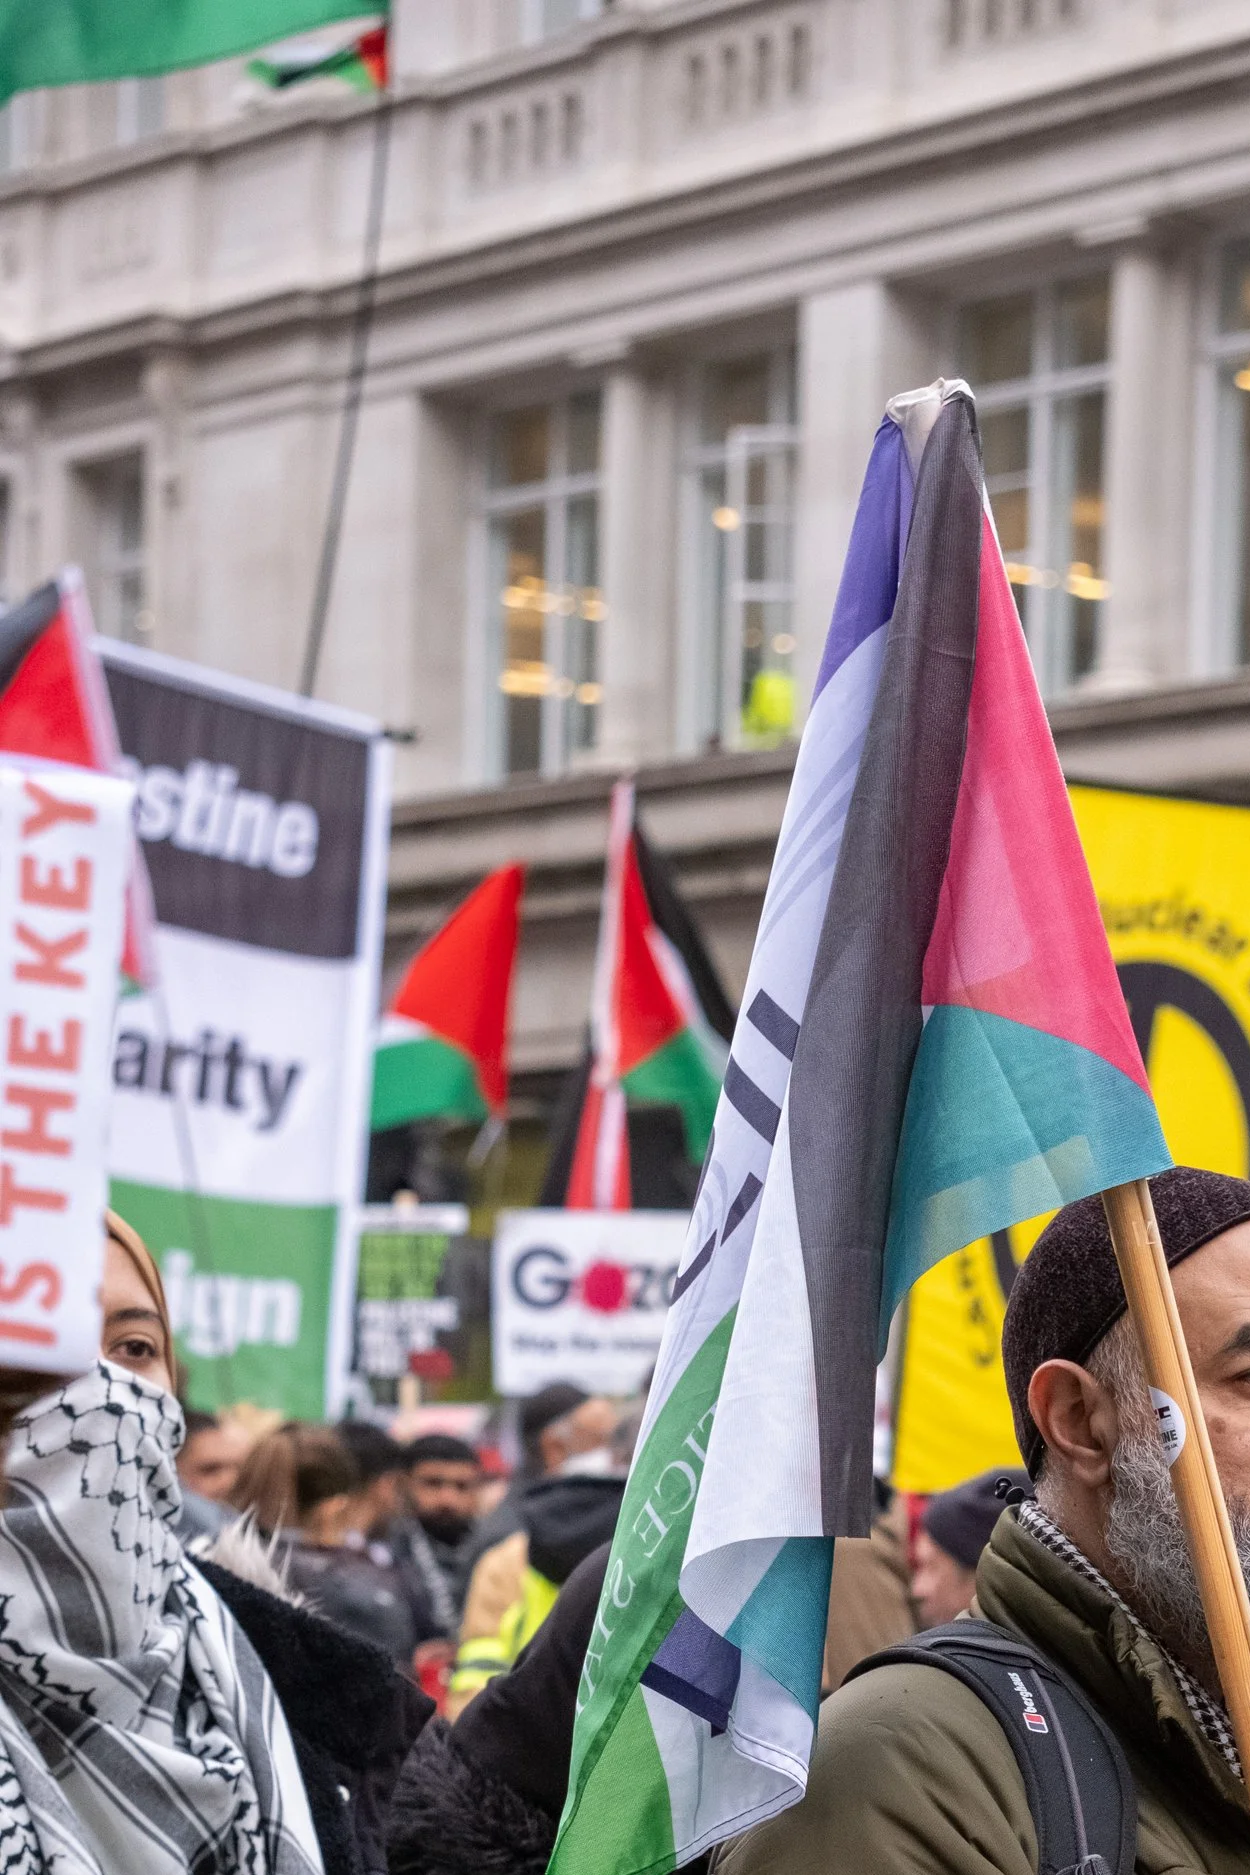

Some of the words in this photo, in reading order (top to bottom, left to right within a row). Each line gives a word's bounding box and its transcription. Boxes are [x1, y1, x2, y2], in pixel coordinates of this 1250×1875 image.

[13, 778, 97, 992] KEY
[1100, 886, 1248, 962] uclear
[0, 1013, 82, 1228] THE
[1007, 1671, 1038, 1714] berghaus
